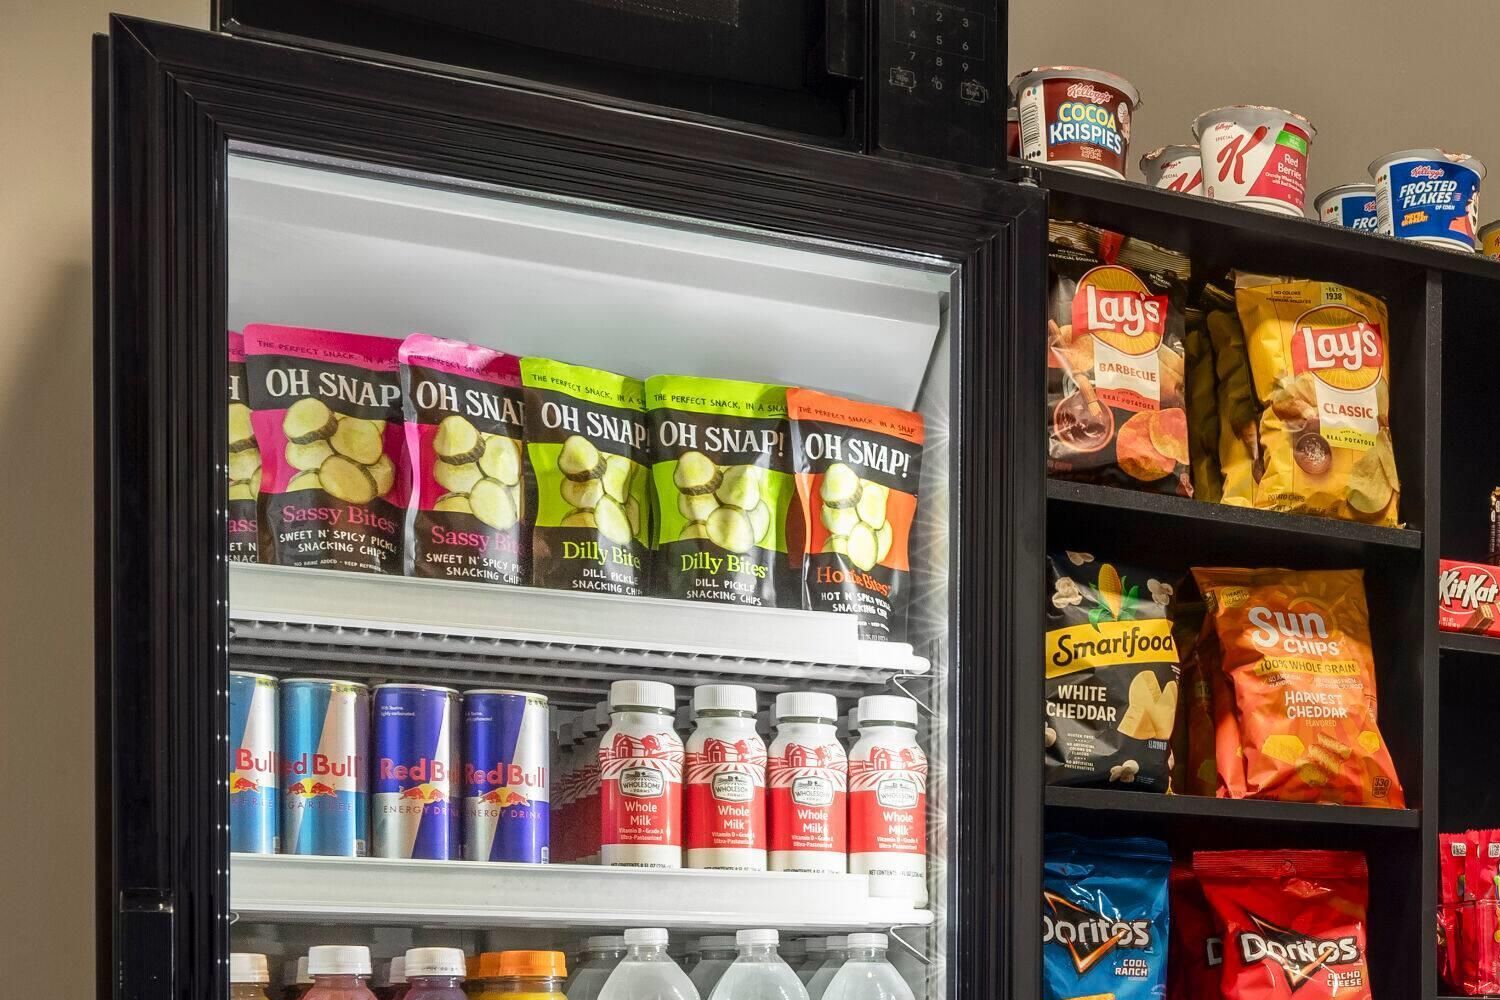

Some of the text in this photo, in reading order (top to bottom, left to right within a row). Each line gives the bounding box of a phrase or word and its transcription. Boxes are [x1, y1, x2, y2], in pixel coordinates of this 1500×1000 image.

[911, 7, 969, 27] 1 2 3
[910, 30, 969, 50] 4 5 6
[910, 52, 968, 72] 7 8 9
[936, 81, 942, 90] 0
[1067, 84, 1111, 103] Kellogg's
[1059, 104, 1117, 132] COCOA
[1050, 123, 1121, 155] KRISPIES
[1217, 126, 1267, 184] K
[1284, 153, 1299, 167] Red
[1278, 162, 1302, 180] Berries
[1411, 166, 1444, 178] Kellogg's
[1399, 180, 1457, 197] FROSTED
[1403, 192, 1452, 209] FLAKES
[1326, 292, 1343, 300] 1938
[1087, 285, 1160, 337] Lay's
[1302, 322, 1378, 370] Lay's
[1100, 363, 1157, 382] BARBECUE
[266, 369, 311, 396] OH
[417, 381, 458, 412] OH
[672, 395, 706, 406] PERFECT
[541, 402, 580, 433] OH
[1323, 403, 1373, 419] CLASSIC
[659, 421, 783, 457] OH SNAP!
[1345, 437, 1375, 447] POTATOES
[805, 433, 911, 478] OH SNAP!
[283, 505, 395, 533] Sassy Bites
[280, 530, 366, 543] SWEET SPICY
[431, 526, 490, 547] Sassy
[298, 542, 387, 560] SNACKING CHIPS
[426, 553, 464, 565] SWEET
[563, 542, 609, 566] Dilly
[446, 566, 499, 580] SNACKING
[681, 552, 765, 578] Dilly Bites
[583, 569, 607, 579] DILL
[573, 580, 622, 594] SNACKING
[696, 578, 754, 593] DILL PICKLE
[686, 590, 762, 606] SNACKING CHIPS
[1249, 607, 1328, 648] Sun
[1053, 627, 1173, 666] Smartfood
[1284, 638, 1339, 656] CHIPS
[1261, 659, 1355, 673] 100% WHOLE GRAIN
[1058, 685, 1107, 702] WHITE
[1285, 691, 1343, 706] HARVEST
[1046, 702, 1116, 722] CHEDDAR
[1287, 706, 1348, 719] CHEDDAR
[312, 754, 359, 777] Bull
[380, 758, 426, 781] Red
[465, 763, 544, 788] Red Bull
[384, 805, 428, 814] ENERGY
[624, 801, 657, 814] Whole
[718, 805, 750, 817] Whole
[797, 810, 828, 822] Whole
[630, 814, 652, 826] Milk
[723, 819, 745, 830] Milk
[883, 811, 913, 824] Whole
[889, 825, 909, 835] Milk
[1241, 933, 1357, 964] Doritos
[1115, 967, 1148, 976] RANCH
[1123, 959, 1147, 967] COOL
[1327, 978, 1362, 987] CHEESE
[1328, 971, 1361, 979] NACHO
